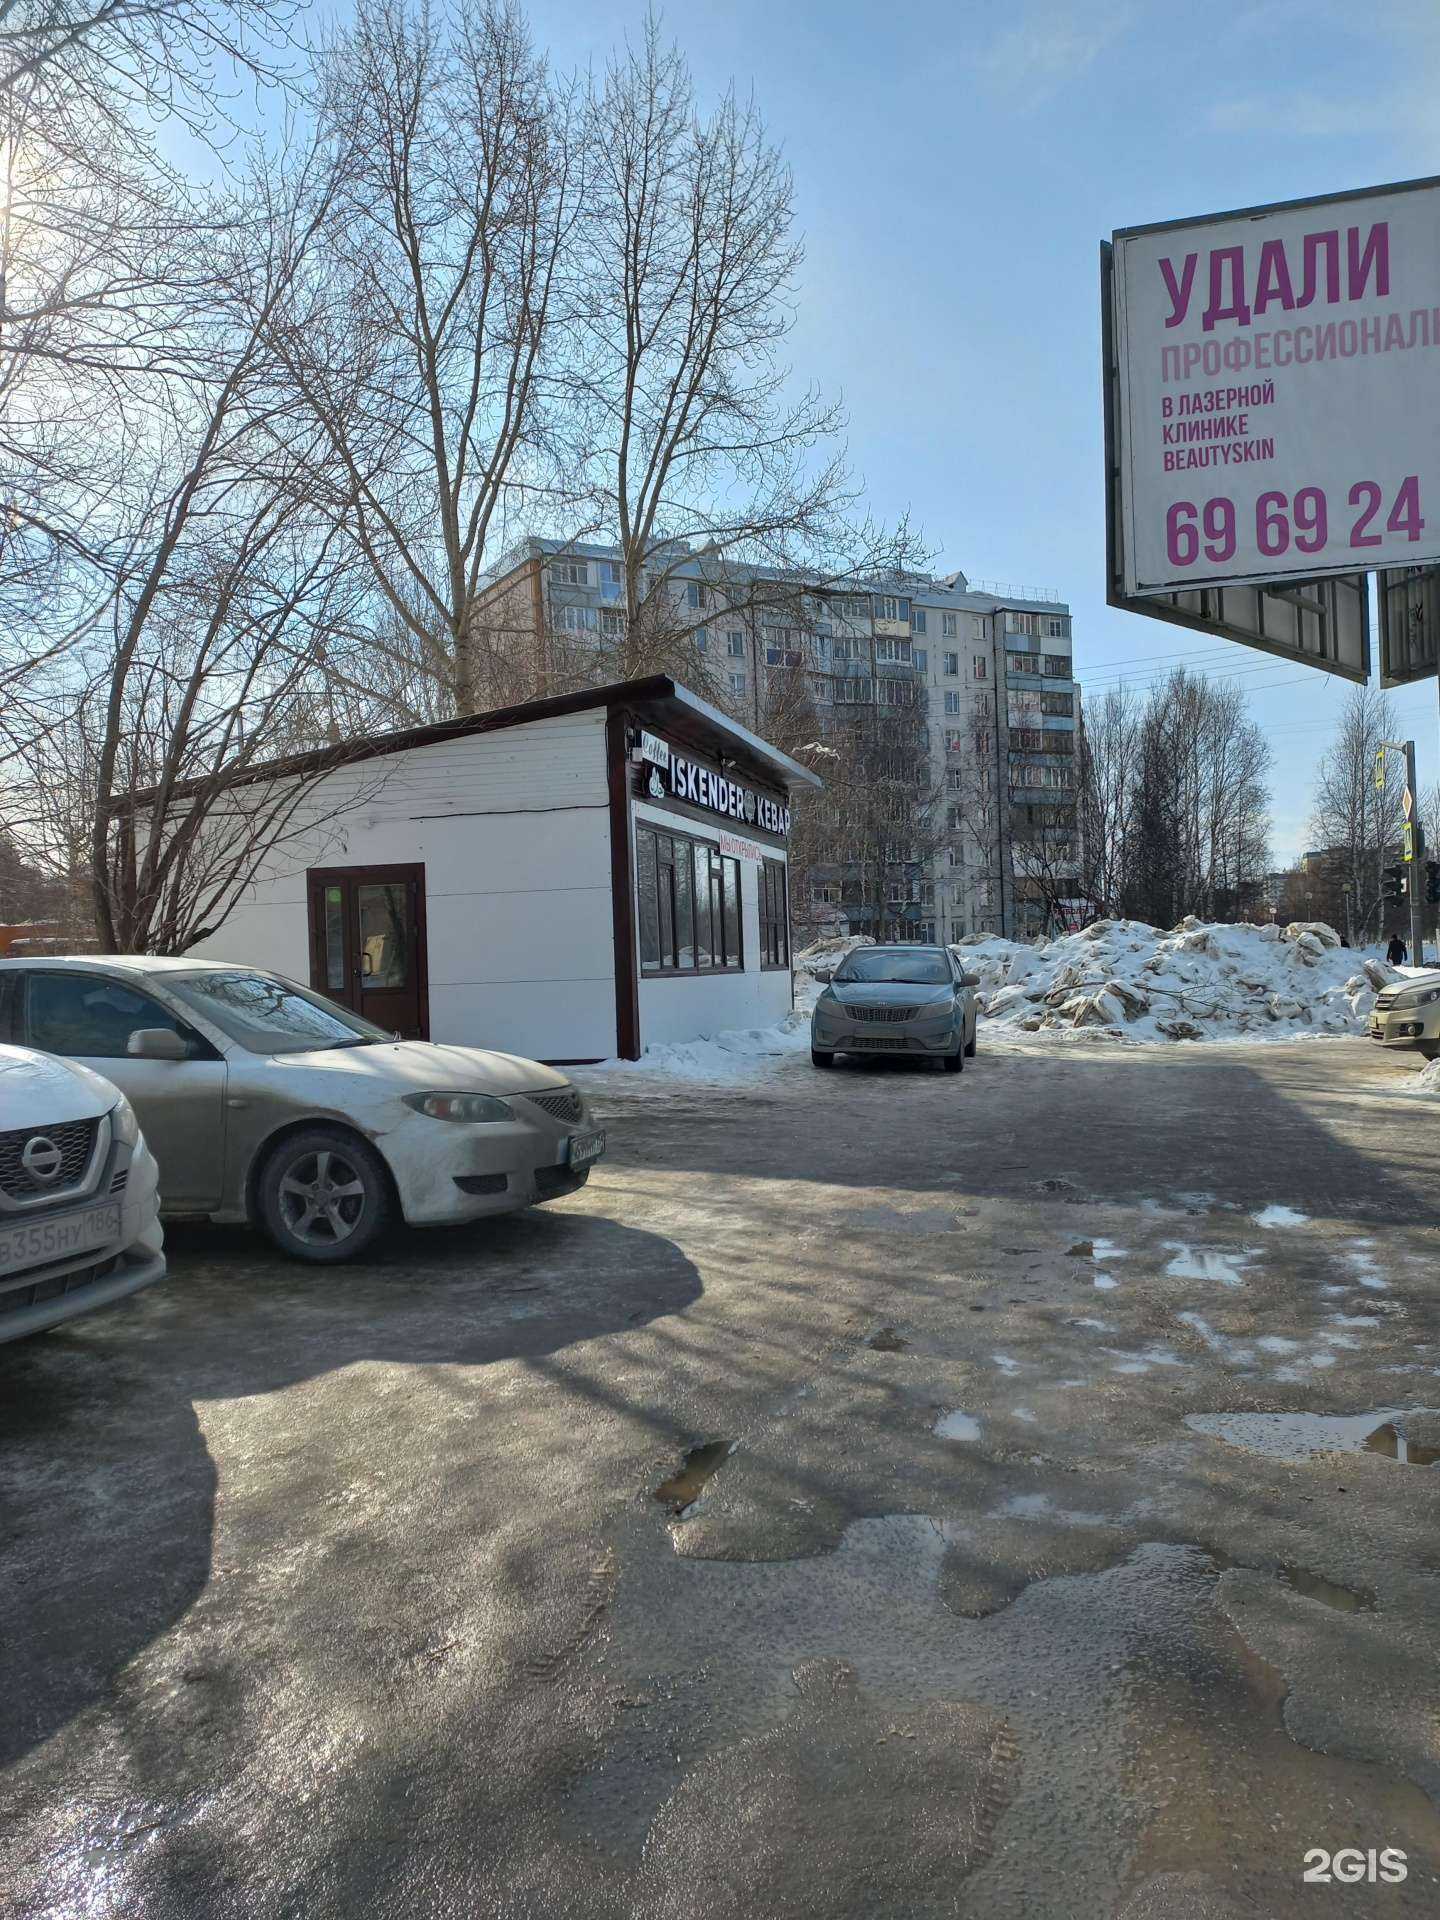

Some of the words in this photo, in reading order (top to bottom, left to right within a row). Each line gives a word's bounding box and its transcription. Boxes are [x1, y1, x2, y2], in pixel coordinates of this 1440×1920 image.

[1158, 221, 1390, 332] УДАЛИ
[1162, 396, 1174, 418] В
[1178, 378, 1276, 416] ЛАЗЕРНОЙ
[1162, 413, 1249, 445] КЛИНИКЕ
[1163, 438, 1275, 472] BEAUTYSKIN
[1166, 497, 1237, 567] 69
[1255, 486, 1328, 558] 69
[1347, 475, 1426, 549] 24
[670, 754, 745, 821] ISKENDER
